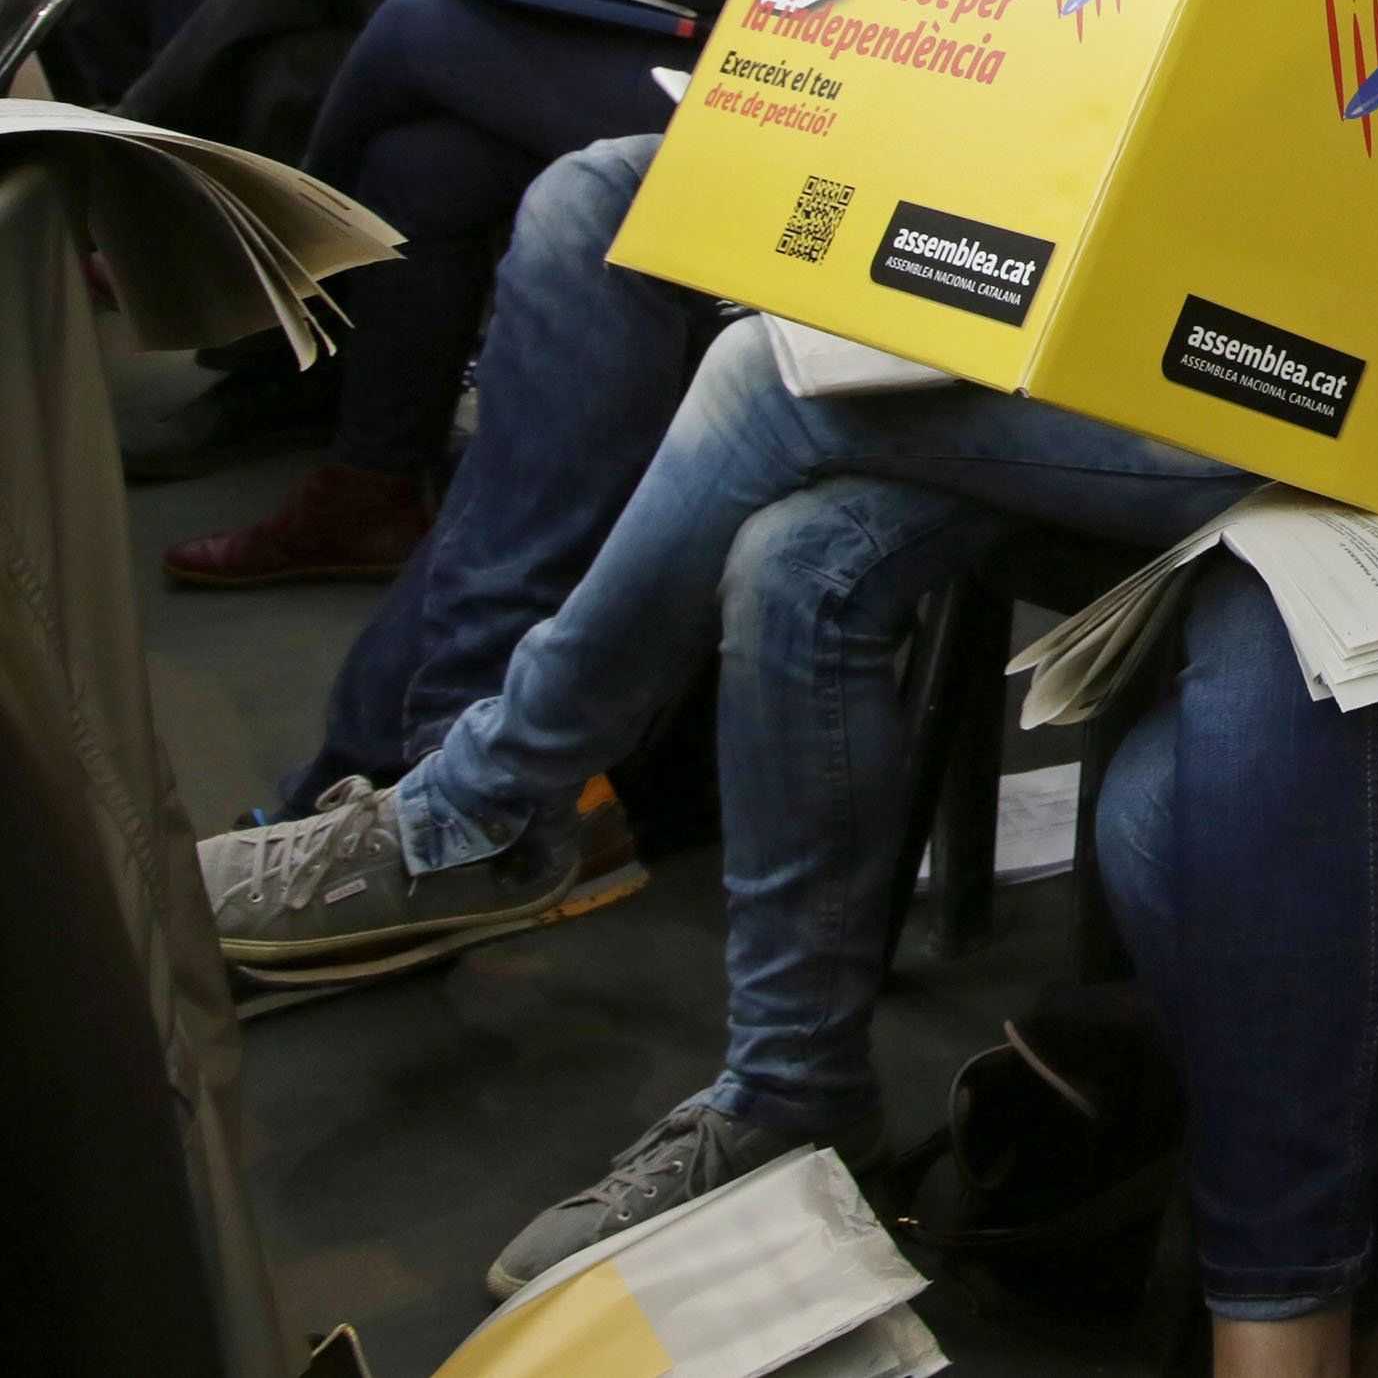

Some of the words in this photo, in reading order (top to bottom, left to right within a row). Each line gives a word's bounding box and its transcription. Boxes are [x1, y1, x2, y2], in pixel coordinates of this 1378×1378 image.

[719, 51, 792, 89] Exerceix
[792, 67, 811, 94] el
[812, 75, 843, 101] teu
[704, 83, 741, 110] dret
[741, 92, 765, 119] de
[760, 101, 838, 138] petició!
[885, 254, 935, 279] ASSEMBLEA
[935, 268, 977, 294] NACIONAL
[977, 282, 1022, 306] CATALANA
[892, 227, 1036, 286] assemblea.cat
[1180, 353, 1239, 385] ASSEMBLEA
[1239, 373, 1287, 403] NACIONAL
[1288, 392, 1336, 418] CATALANA
[1188, 324, 1348, 400] assemblea.cat
